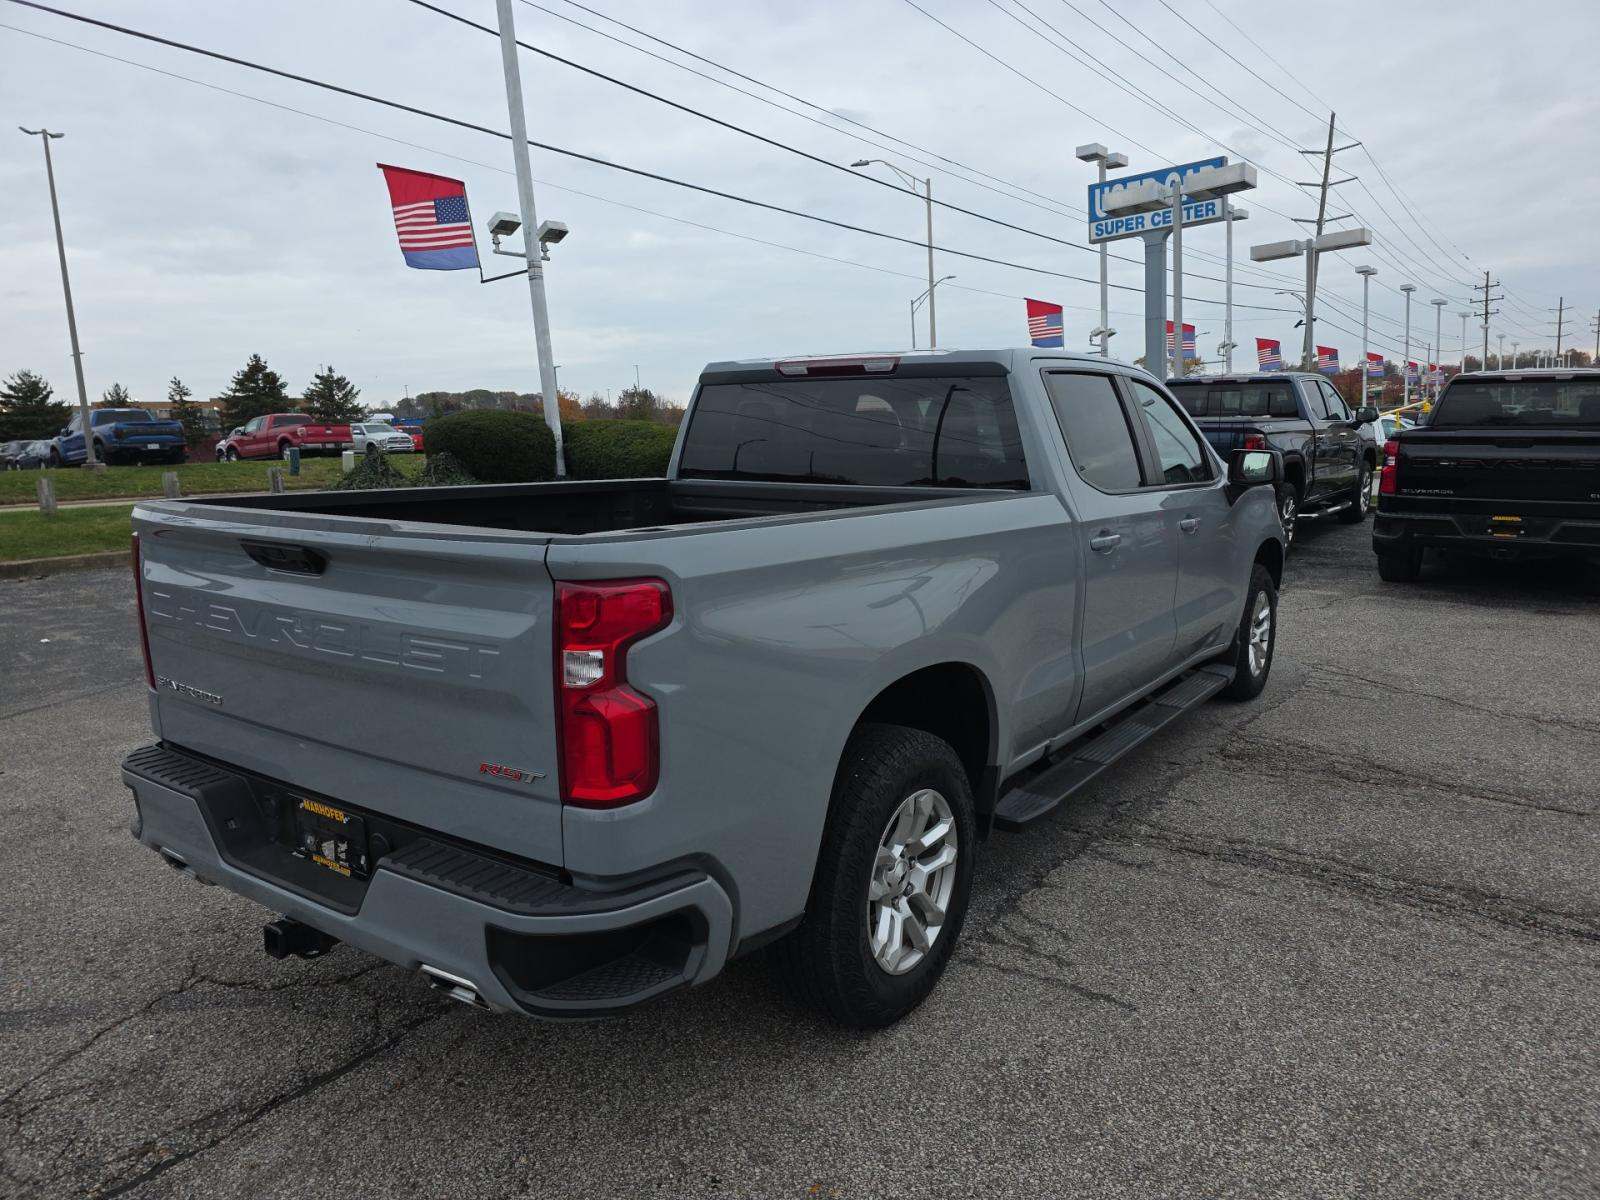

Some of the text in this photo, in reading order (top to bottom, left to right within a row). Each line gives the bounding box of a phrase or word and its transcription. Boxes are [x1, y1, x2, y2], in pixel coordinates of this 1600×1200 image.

[1095, 201, 1216, 237] SUPER CETER
[151, 591, 500, 678] CHEVROLET
[480, 763, 545, 784] RST
